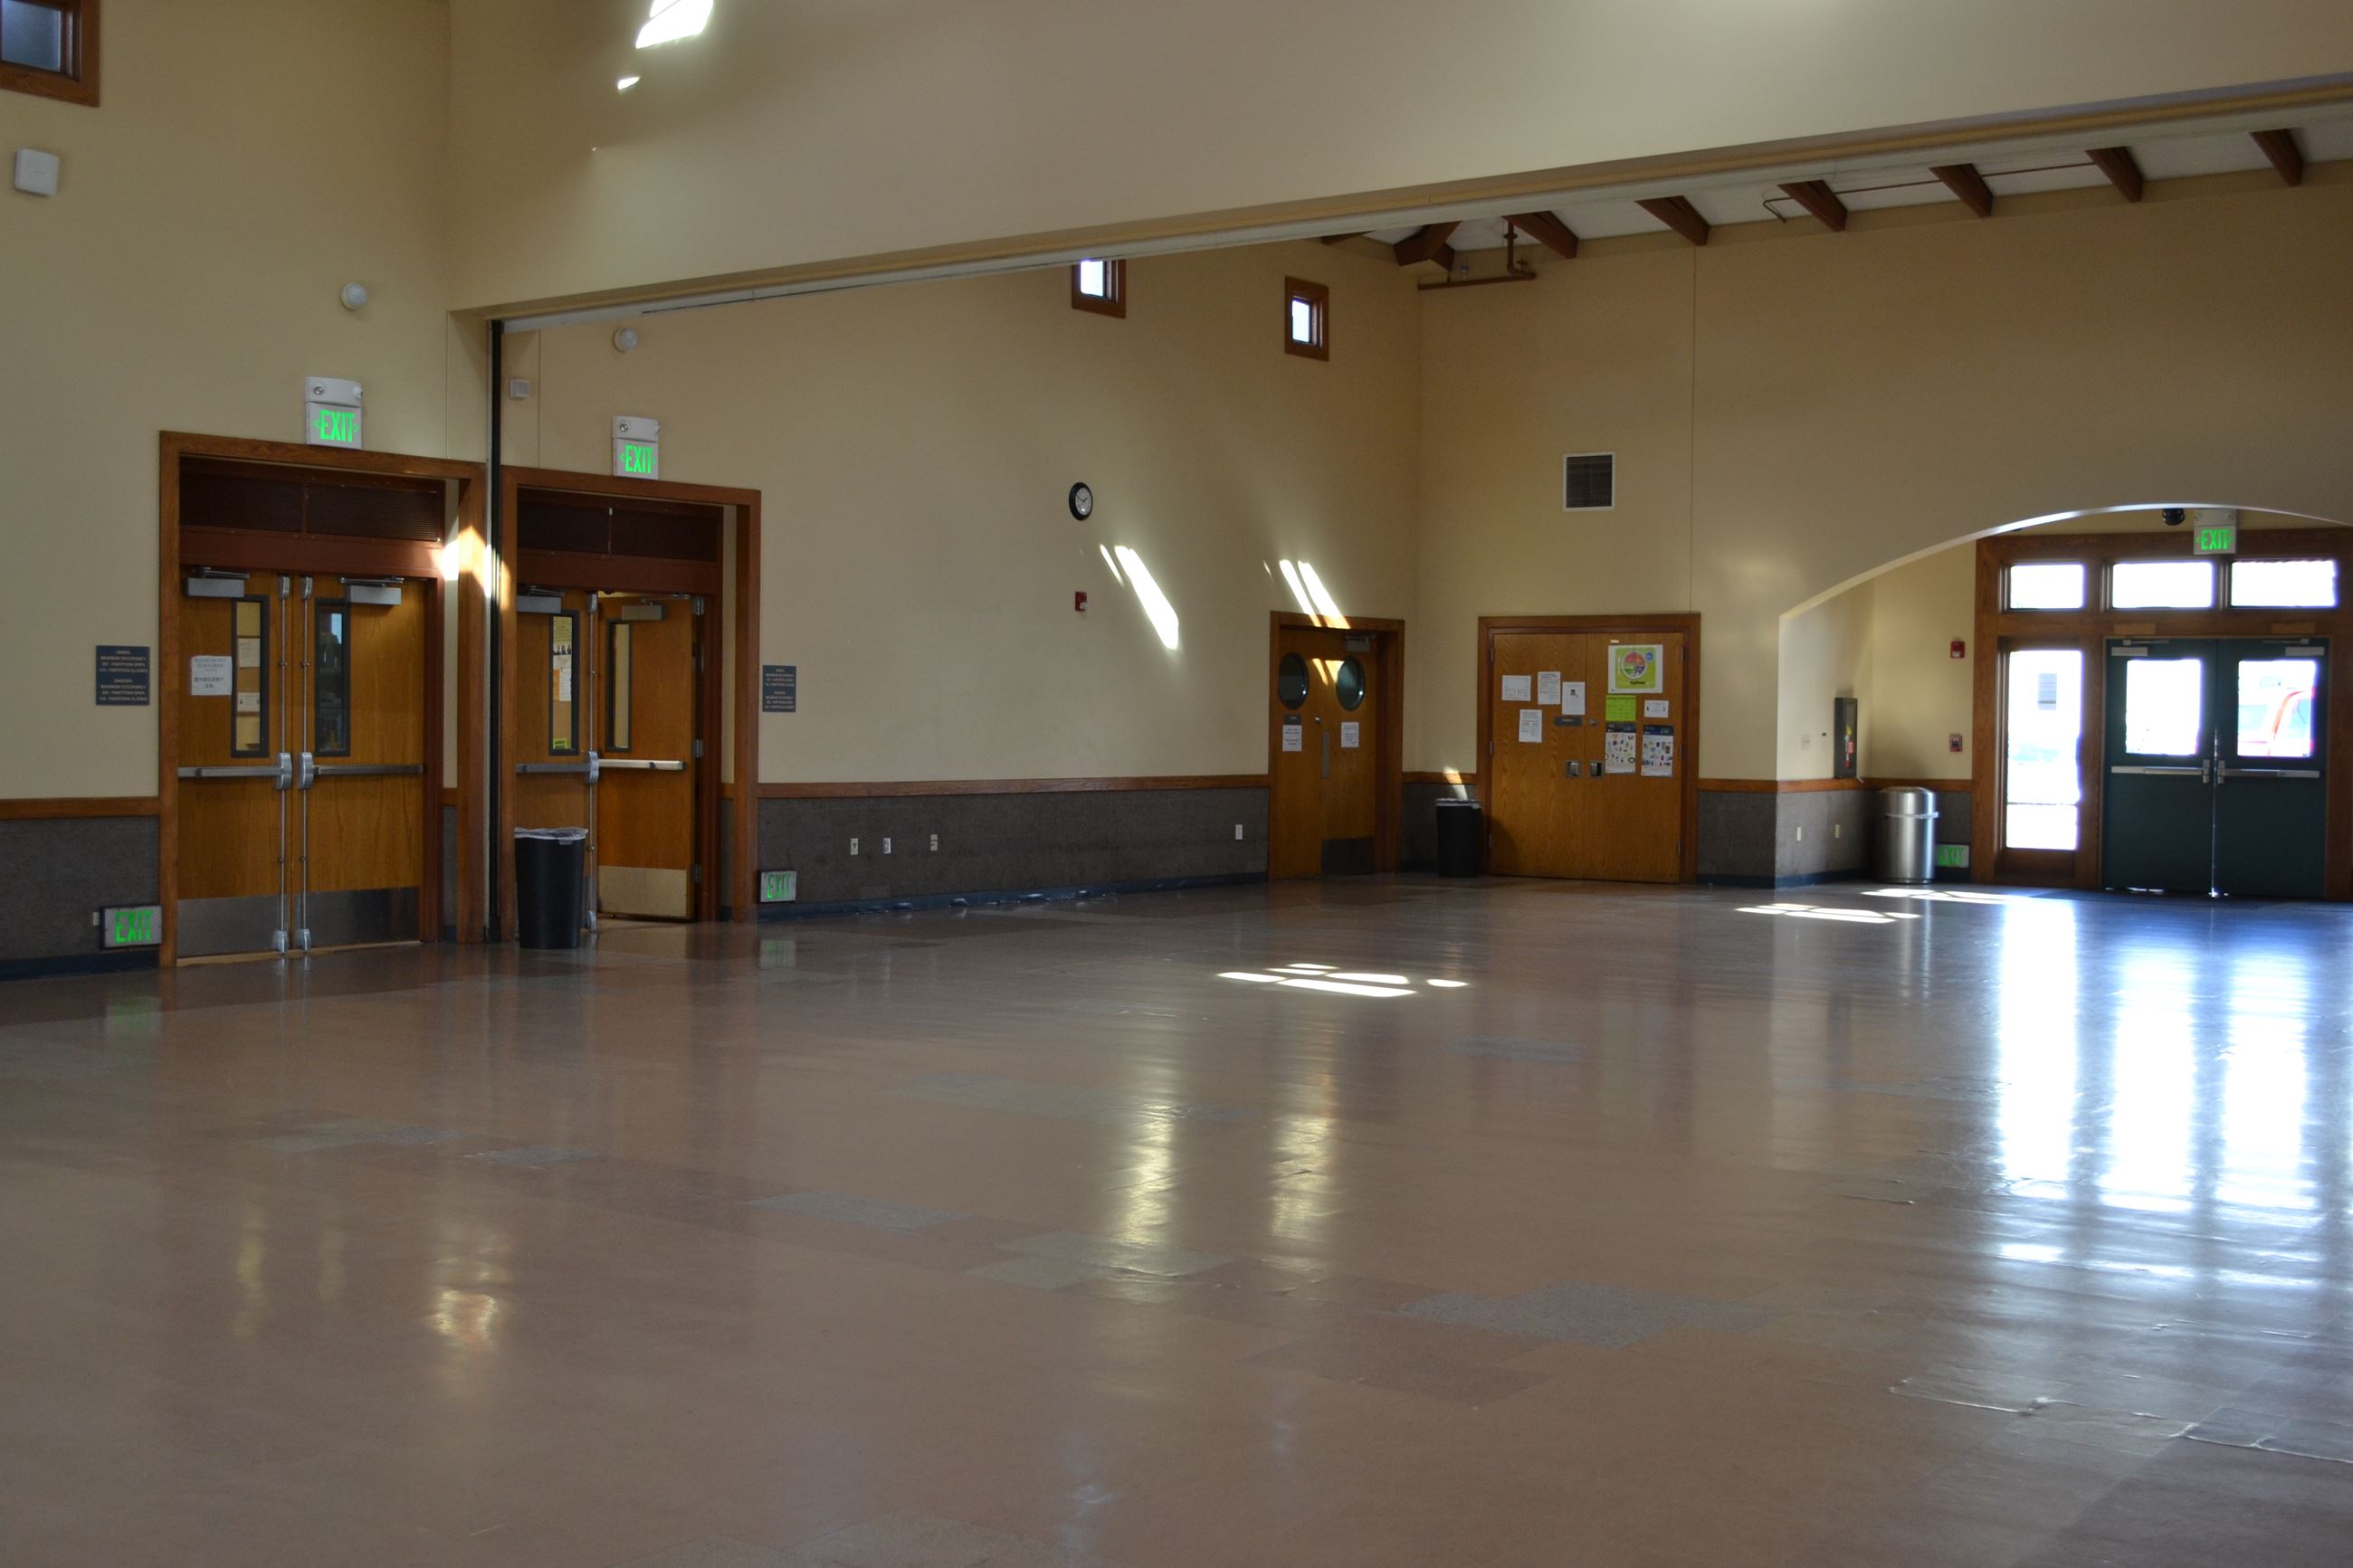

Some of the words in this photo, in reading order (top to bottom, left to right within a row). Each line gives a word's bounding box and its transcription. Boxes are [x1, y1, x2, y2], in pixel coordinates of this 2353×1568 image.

[319, 409, 355, 442] EXIT
[624, 443, 653, 474] EXIT
[2201, 528, 2230, 551] EXIT
[1939, 845, 1965, 866] EXIT
[767, 872, 792, 898] EXIT
[115, 908, 153, 943] EXIT
